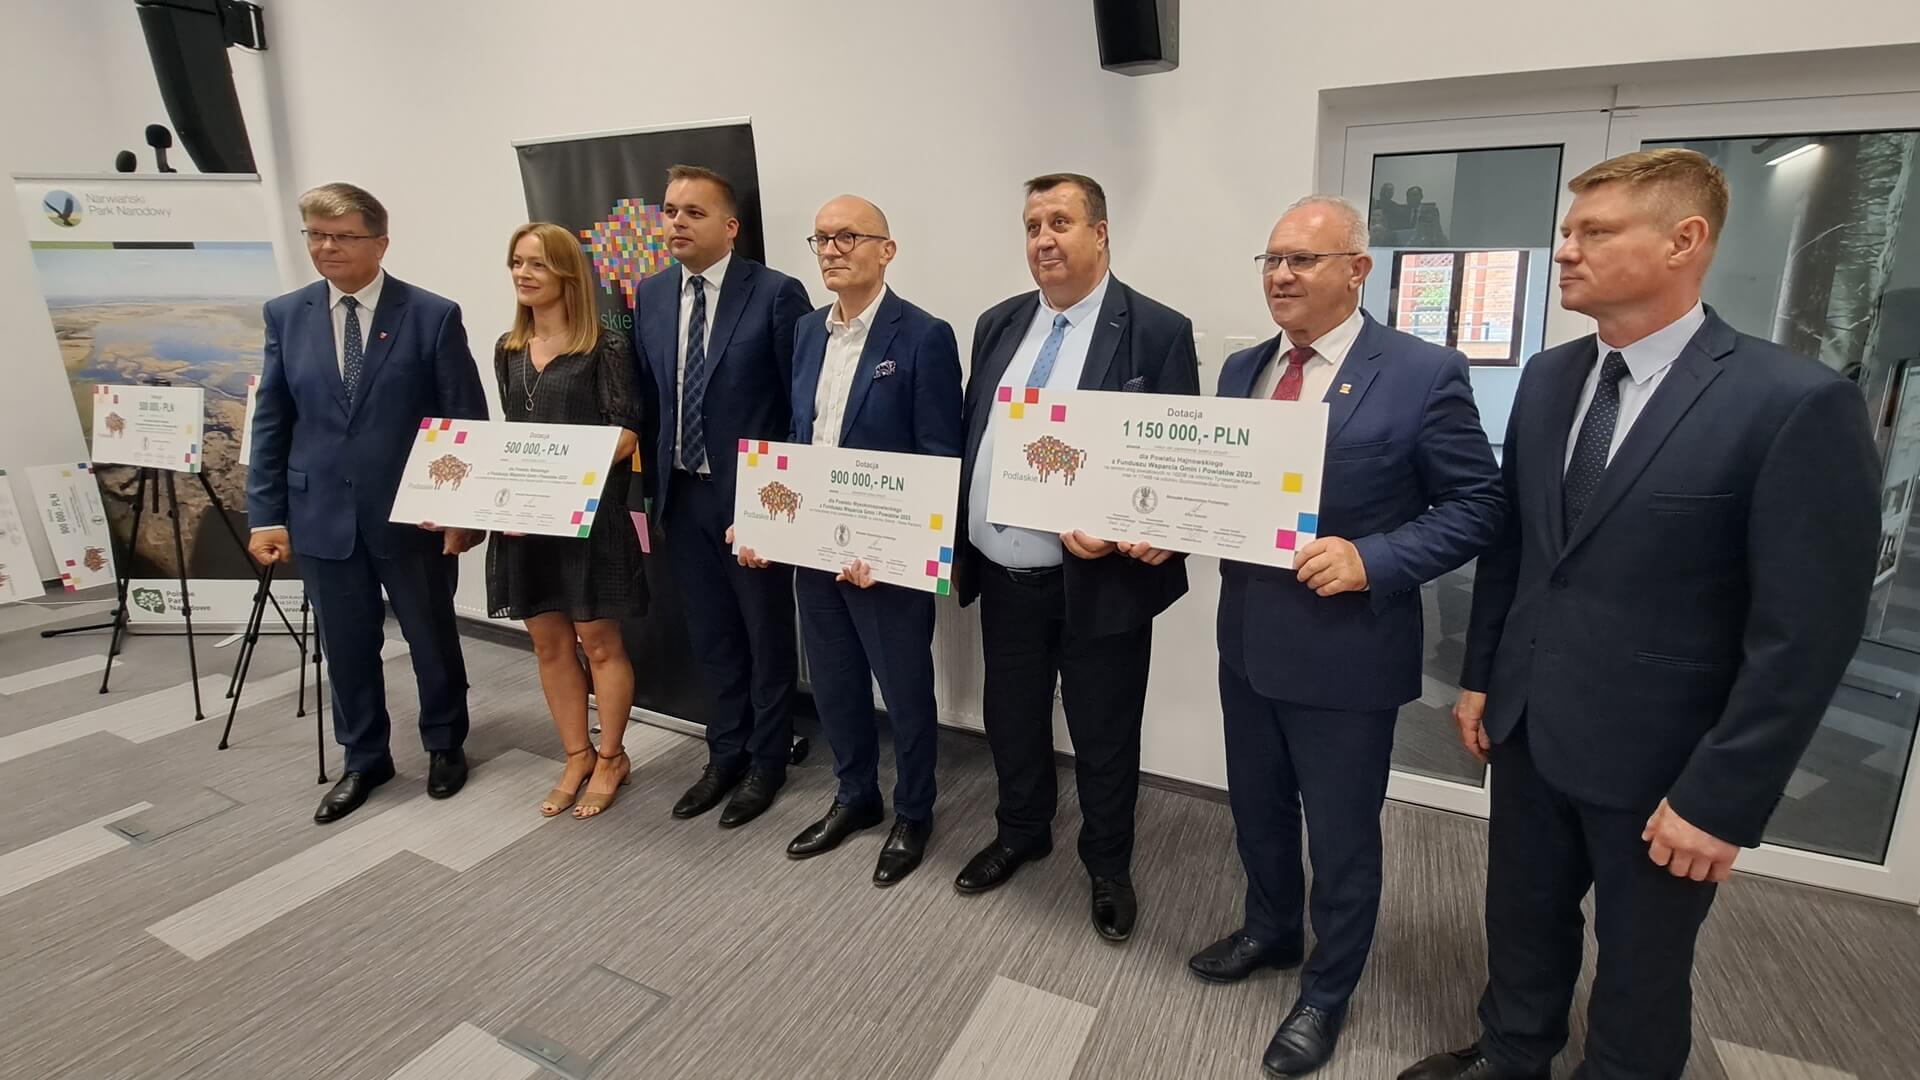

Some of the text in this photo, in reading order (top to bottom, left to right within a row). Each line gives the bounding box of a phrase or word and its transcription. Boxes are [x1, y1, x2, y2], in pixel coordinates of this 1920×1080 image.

[88, 205, 171, 218] Park Narodowy
[600, 309, 633, 329] skie
[1167, 407, 1203, 420] Dotacja
[1123, 420, 1250, 446] 1 150 000,- PLN
[504, 441, 521, 454] 500
[547, 443, 569, 456] PLN
[855, 460, 879, 470] Dotacja
[830, 470, 904, 491] 900 000,- PLN
[1003, 470, 1038, 481] Podlaskie
[1236, 470, 1253, 478] 2023
